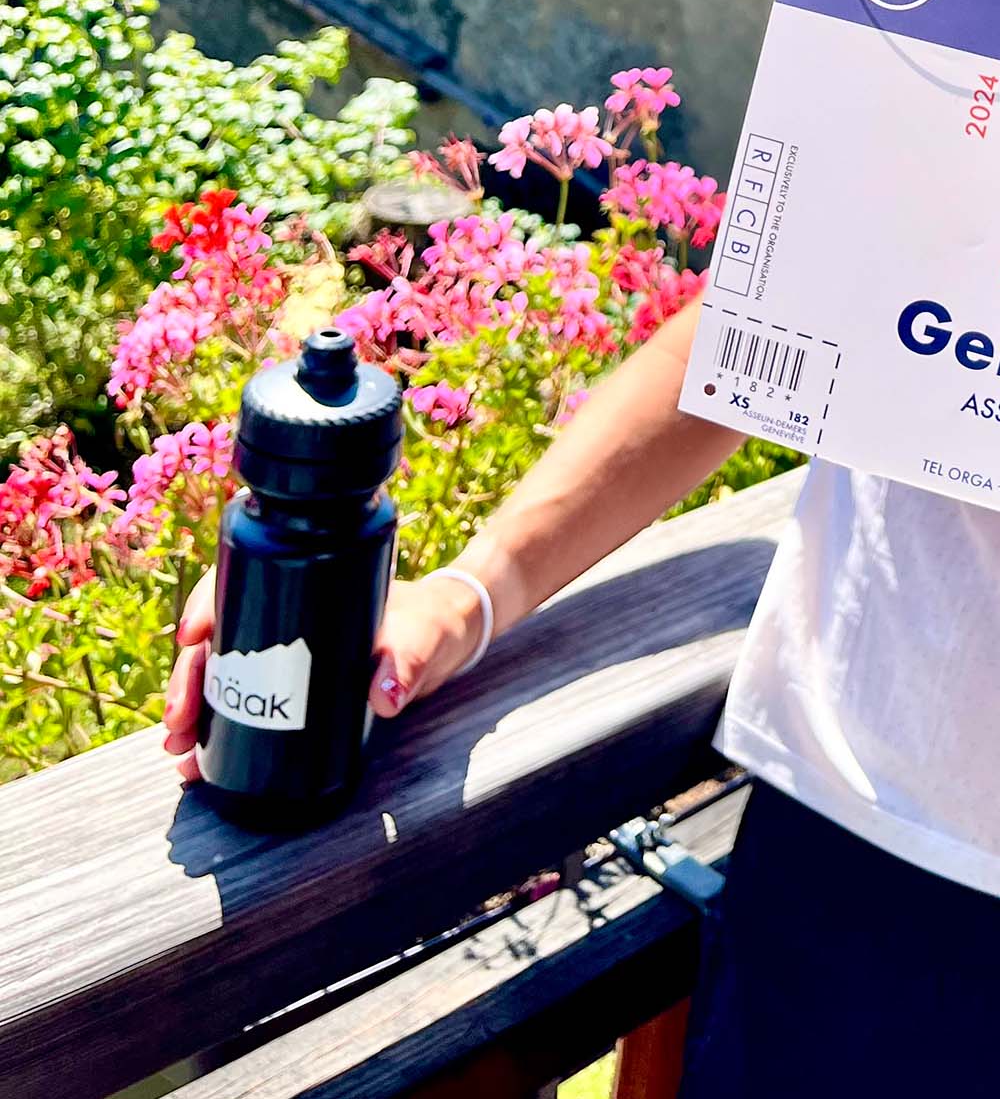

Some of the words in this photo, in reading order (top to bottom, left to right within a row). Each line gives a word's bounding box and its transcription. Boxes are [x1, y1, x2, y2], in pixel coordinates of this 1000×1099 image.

[965, 75, 1000, 139] 2024
[780, 145, 799, 199] EXCLUSIVELY
[771, 215, 783, 232] THE
[775, 202, 785, 213] TO
[755, 234, 777, 301] ORGANISATION
[729, 392, 750, 409] XS
[789, 411, 810, 426] 182
[743, 409, 807, 435] ASSELIN-DEMERS
[922, 458, 944, 477] TEL
[948, 467, 993, 491] ORGA
